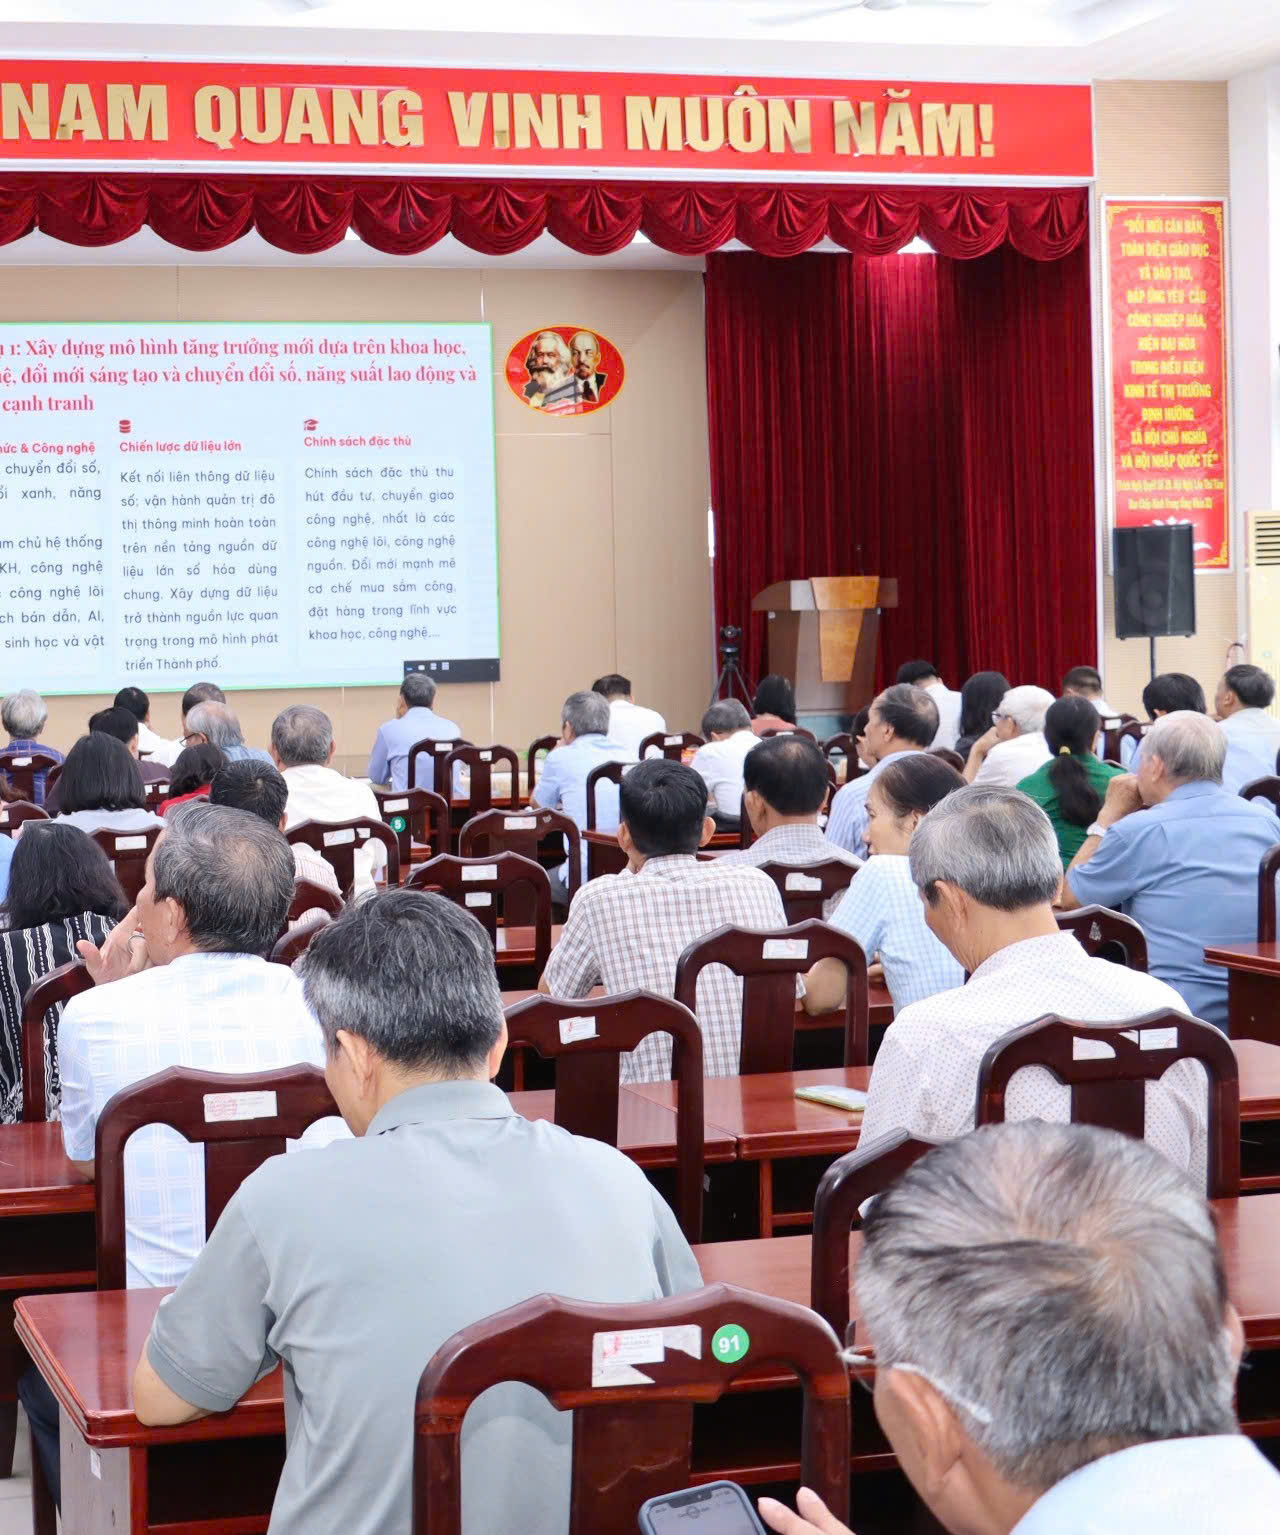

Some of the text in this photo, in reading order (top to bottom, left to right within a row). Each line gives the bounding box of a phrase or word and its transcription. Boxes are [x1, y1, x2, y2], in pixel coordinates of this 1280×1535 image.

[1, 83, 168, 141] NAM
[195, 84, 424, 150] QUANG
[448, 91, 602, 150] VINH
[626, 85, 813, 154] MUÔN
[833, 87, 995, 157] NĂM!
[25, 339, 57, 358] Xây
[61, 338, 105, 358] dựng
[109, 338, 135, 355] mô
[140, 337, 178, 355] hình
[182, 338, 219, 357] tăng
[222, 337, 279, 357] trưởng
[282, 337, 314, 355] mới
[318, 338, 348, 357] dựa
[352, 338, 386, 354] trên
[390, 338, 428, 354] khoa
[433, 338, 466, 357] học,
[21, 363, 47, 383] đổi
[53, 366, 84, 383] mới
[89, 366, 128, 385] sáng
[132, 368, 158, 385] tạo
[162, 365, 180, 382] và
[185, 362, 244, 384] chuyển
[248, 362, 274, 381] đổi
[306, 366, 345, 384] năng
[350, 362, 382, 381] suất
[388, 365, 411, 381] lao
[416, 366, 455, 384] động
[459, 365, 476, 381] và
[2, 394, 43, 415] cạnh
[47, 394, 94, 411] tranh
[20, 442, 29, 453] &
[32, 442, 64, 456] Công
[66, 441, 95, 455] nghệ
[119, 439, 241, 454] Chiến lược dữ liệu lớn
[304, 436, 336, 447] Chính
[338, 435, 366, 446] sách
[368, 435, 390, 448] đặc
[5, 459, 50, 476] chuyển
[56, 459, 76, 473] đổi
[304, 467, 338, 478] Chính
[345, 466, 372, 478] sách
[380, 466, 402, 480] đặc
[435, 467, 453, 477] thu
[120, 469, 274, 484] Kết nối liên thông dữ liệu
[70, 486, 101, 500] năng
[122, 516, 275, 532] thị thông minh hoàn toàn
[306, 513, 335, 527] công
[382, 510, 407, 523] nhất
[433, 512, 454, 522] các
[18, 536, 40, 548] chủ
[46, 536, 60, 550] hệ
[66, 534, 102, 550] thống
[30, 561, 62, 575] công
[72, 560, 102, 575] nghệ
[125, 657, 152, 670] triển
[156, 658, 192, 669] Thành
[718, 1334, 740, 1354] 91
